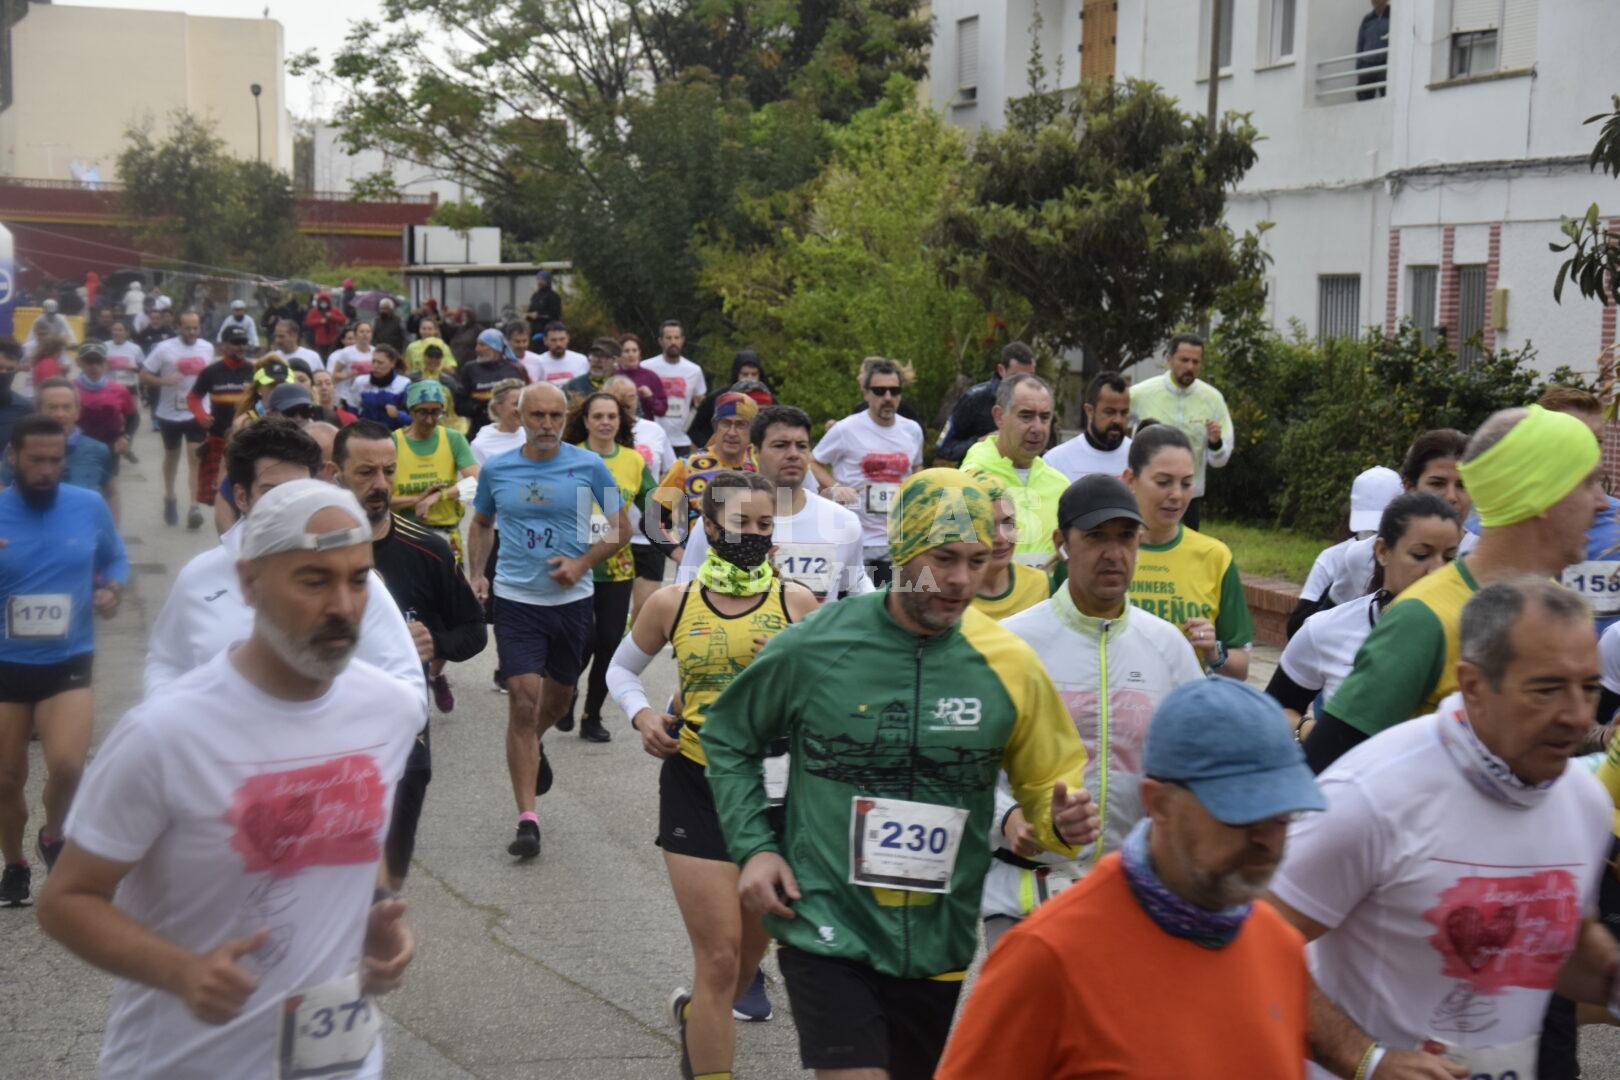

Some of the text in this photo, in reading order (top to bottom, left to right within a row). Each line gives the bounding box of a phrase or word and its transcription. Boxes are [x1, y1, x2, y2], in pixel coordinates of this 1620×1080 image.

[527, 528, 553, 549] 3+2
[784, 557, 828, 574] 172
[1129, 581, 1175, 594] UNNERS
[19, 606, 62, 620] 170
[880, 821, 947, 854] 230
